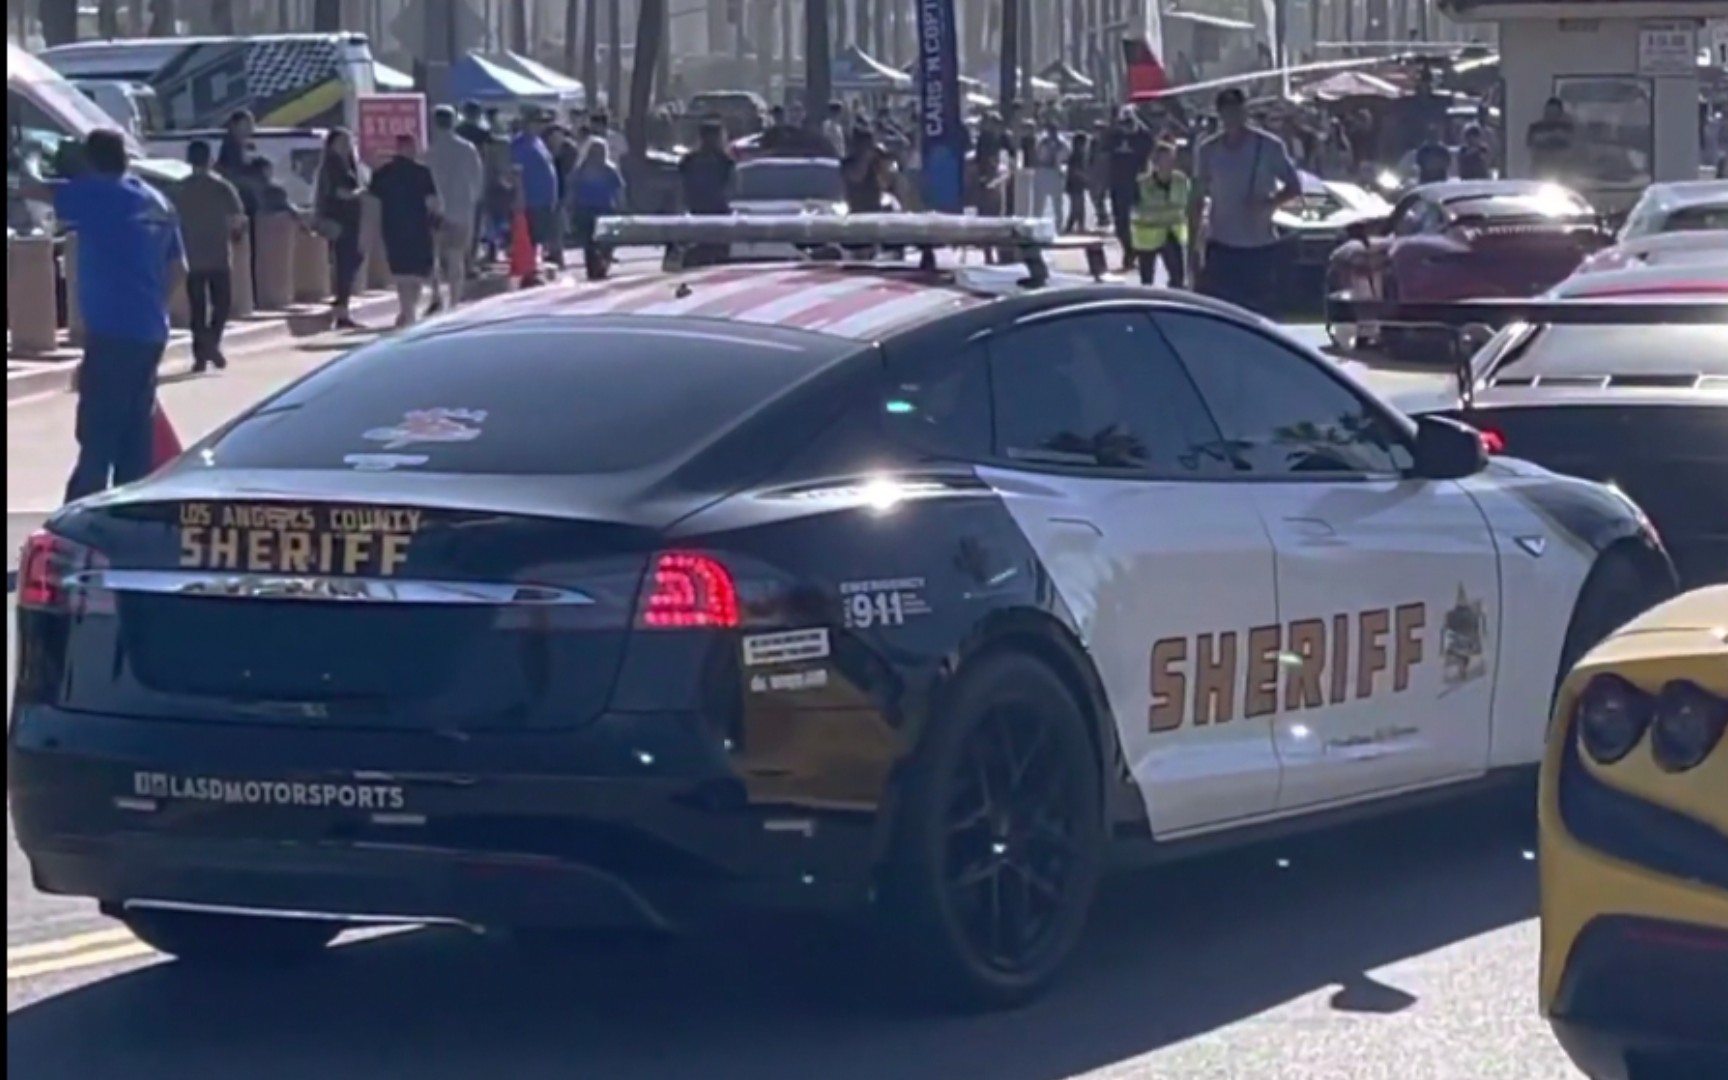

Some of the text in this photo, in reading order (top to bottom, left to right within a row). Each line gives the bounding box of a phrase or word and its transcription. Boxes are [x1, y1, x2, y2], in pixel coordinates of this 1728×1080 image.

[363, 116, 417, 136] STOP
[180, 503, 211, 526] LOS
[330, 508, 421, 532] COUNTY
[179, 527, 411, 575] SHERIFF
[1149, 602, 1425, 732] SHERIFF
[171, 776, 404, 808] LASDMOTORSPORTS
